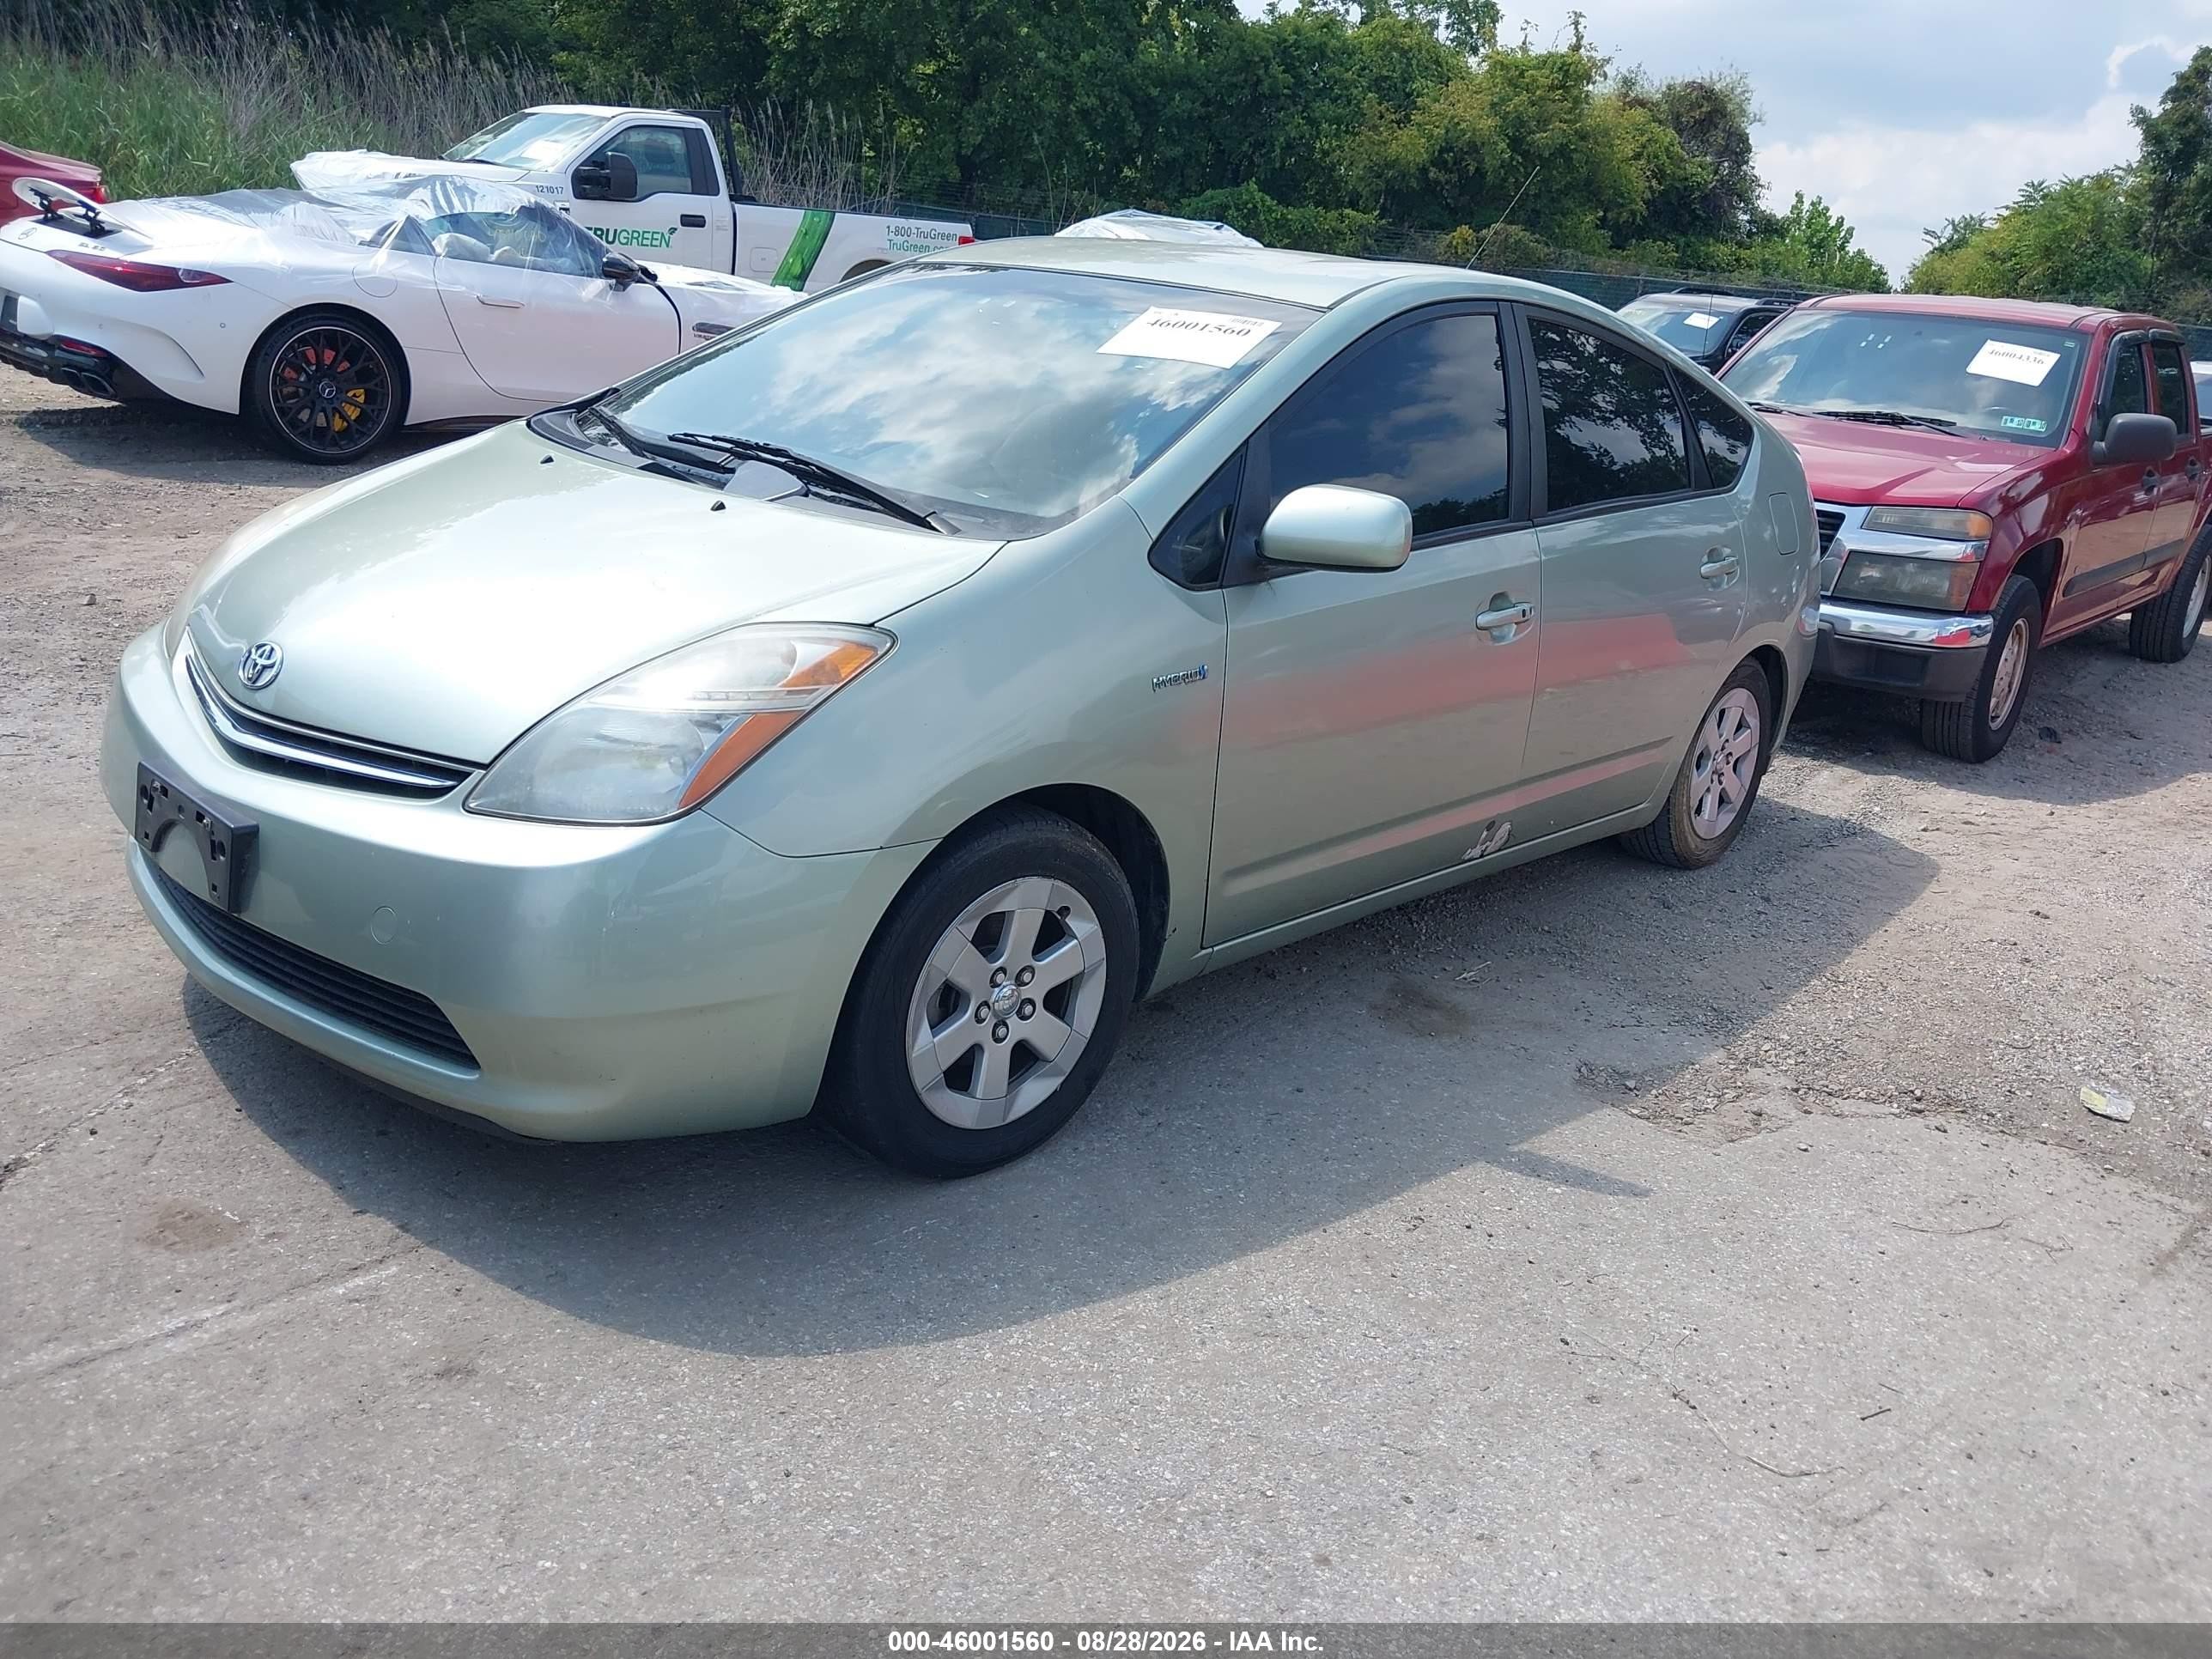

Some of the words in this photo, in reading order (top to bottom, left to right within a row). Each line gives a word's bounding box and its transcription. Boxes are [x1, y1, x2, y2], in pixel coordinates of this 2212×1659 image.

[536, 185, 564, 195] 121017
[886, 225, 957, 241] 1-800-TruGreen
[1147, 318, 1251, 337] 46001560
